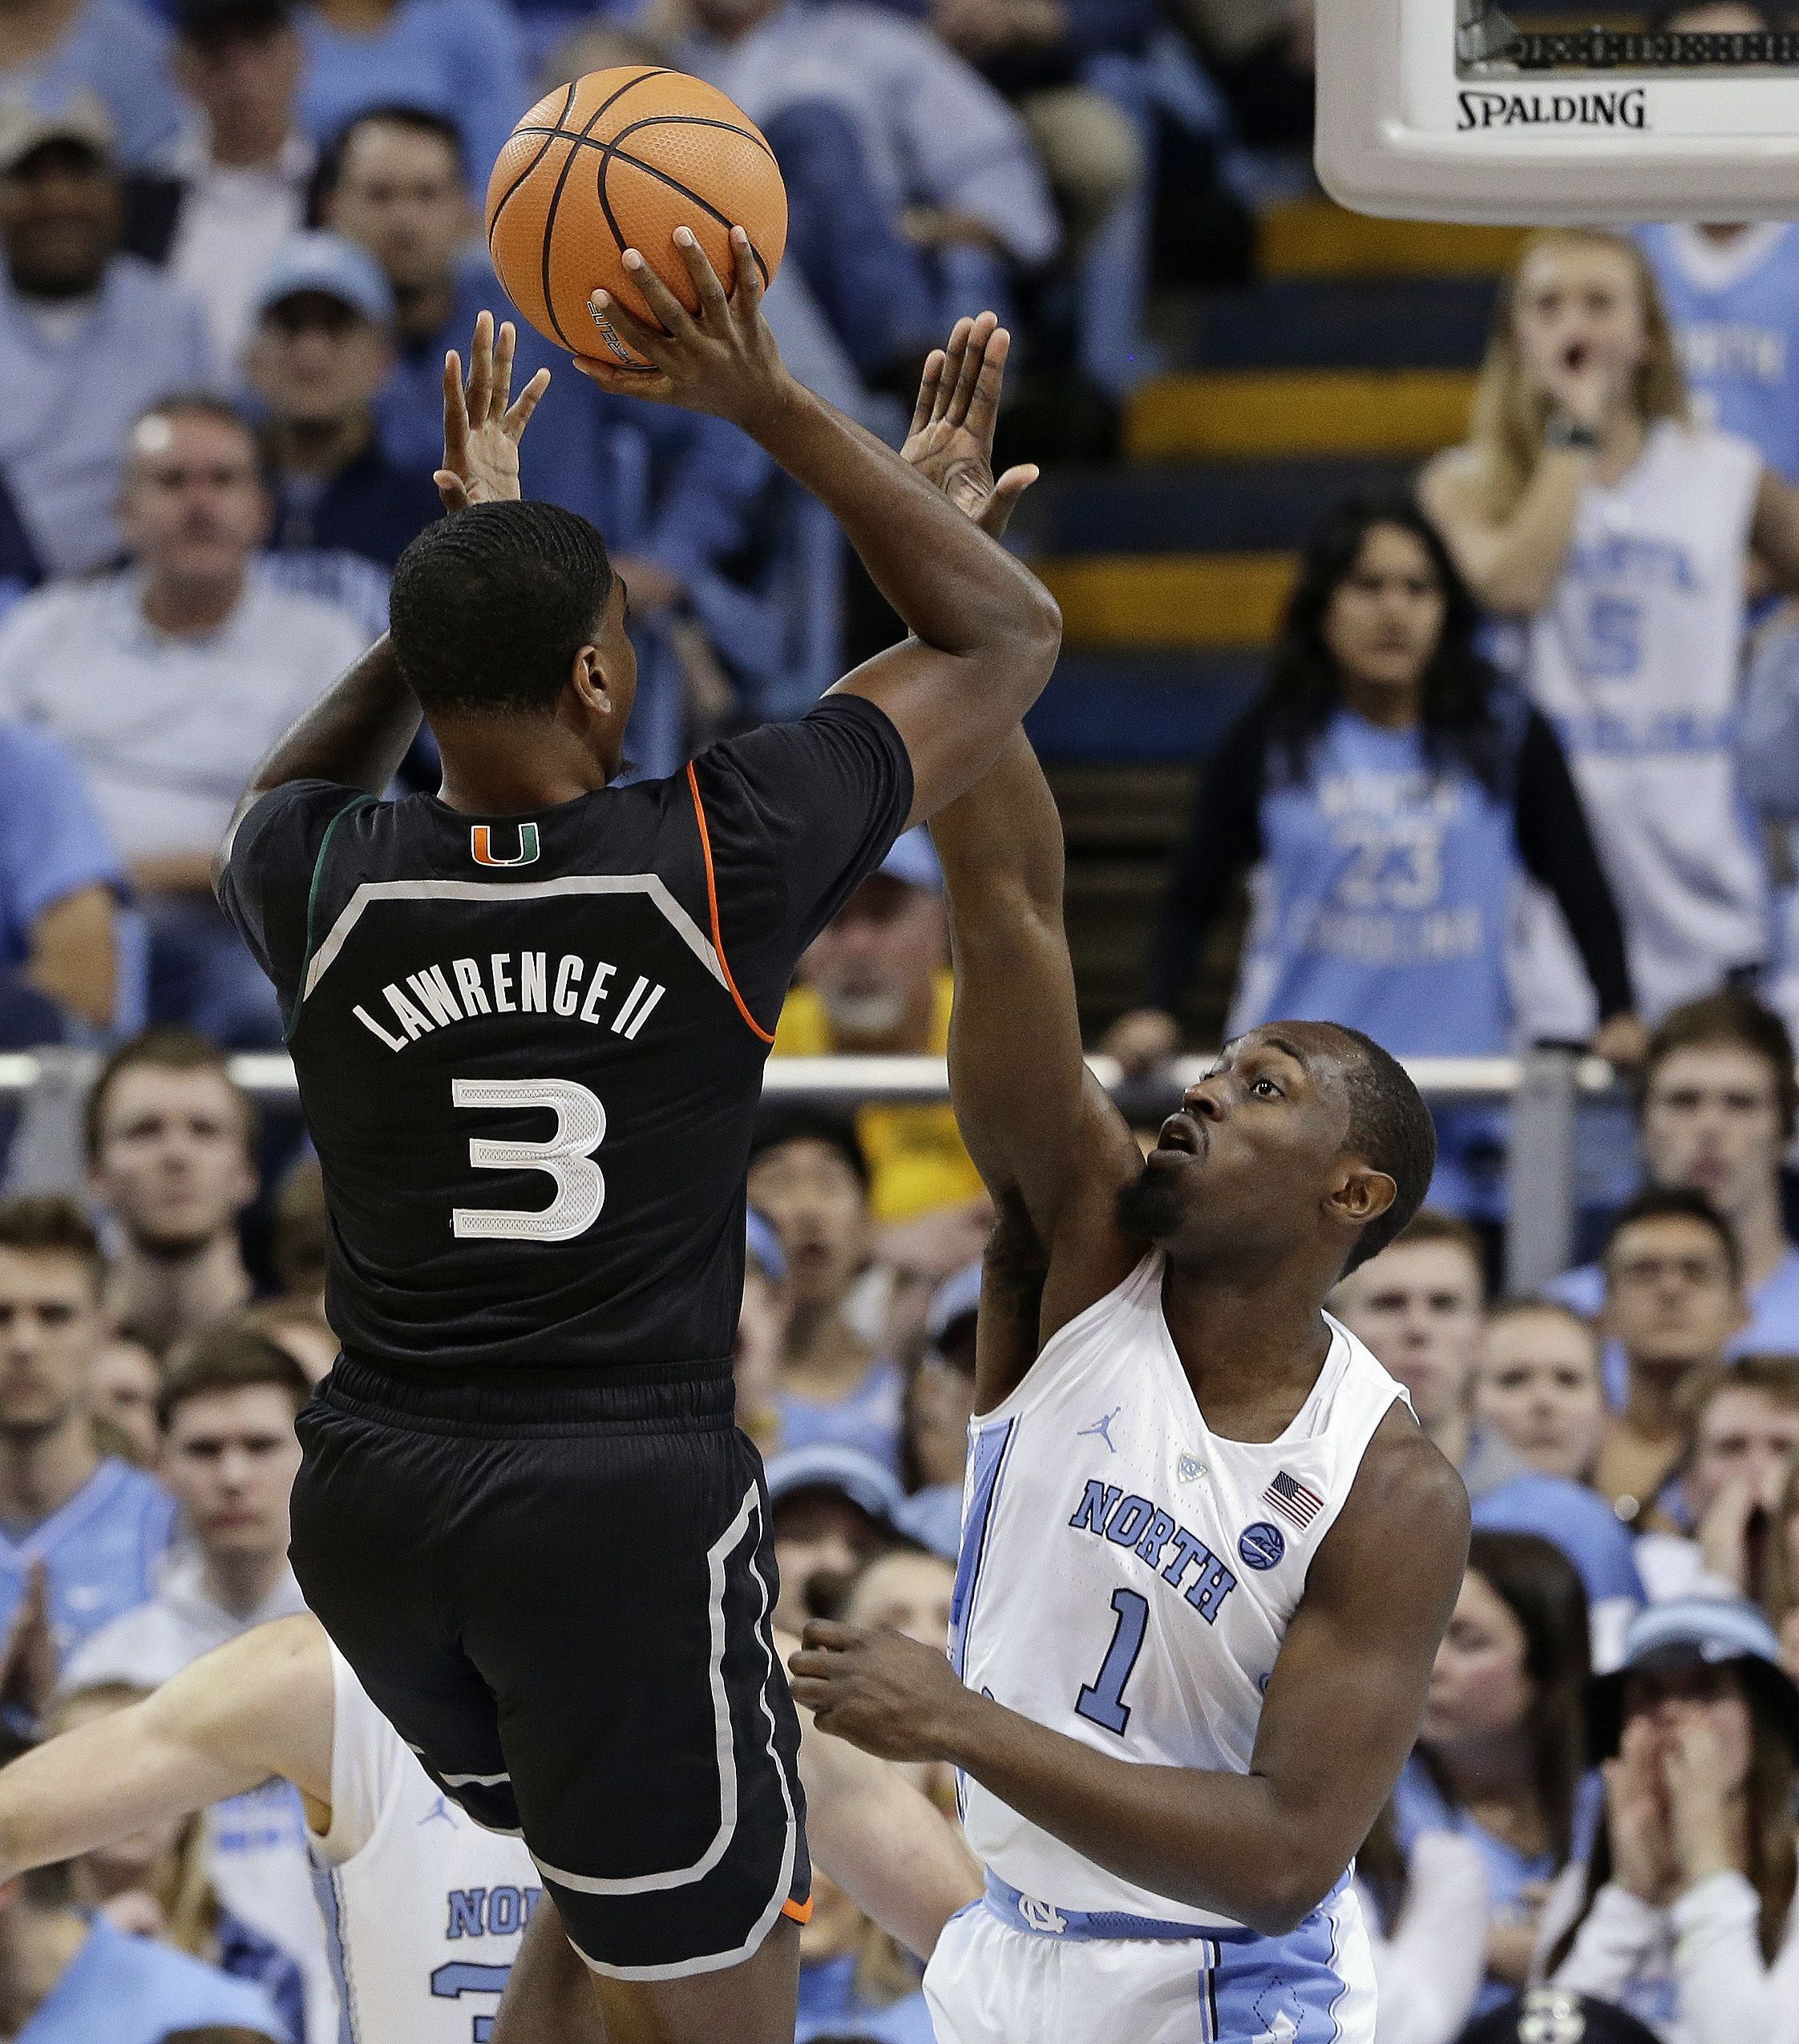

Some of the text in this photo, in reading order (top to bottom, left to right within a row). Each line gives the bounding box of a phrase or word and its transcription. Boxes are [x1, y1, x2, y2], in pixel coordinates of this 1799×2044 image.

[1456, 88, 1646, 130] SPALDING
[471, 822, 540, 866] U
[353, 951, 665, 1052] LAWRENCE II
[451, 1078, 606, 1242] 3
[1069, 1479, 1237, 1625] NORTH
[1075, 1588, 1150, 1736] 1
